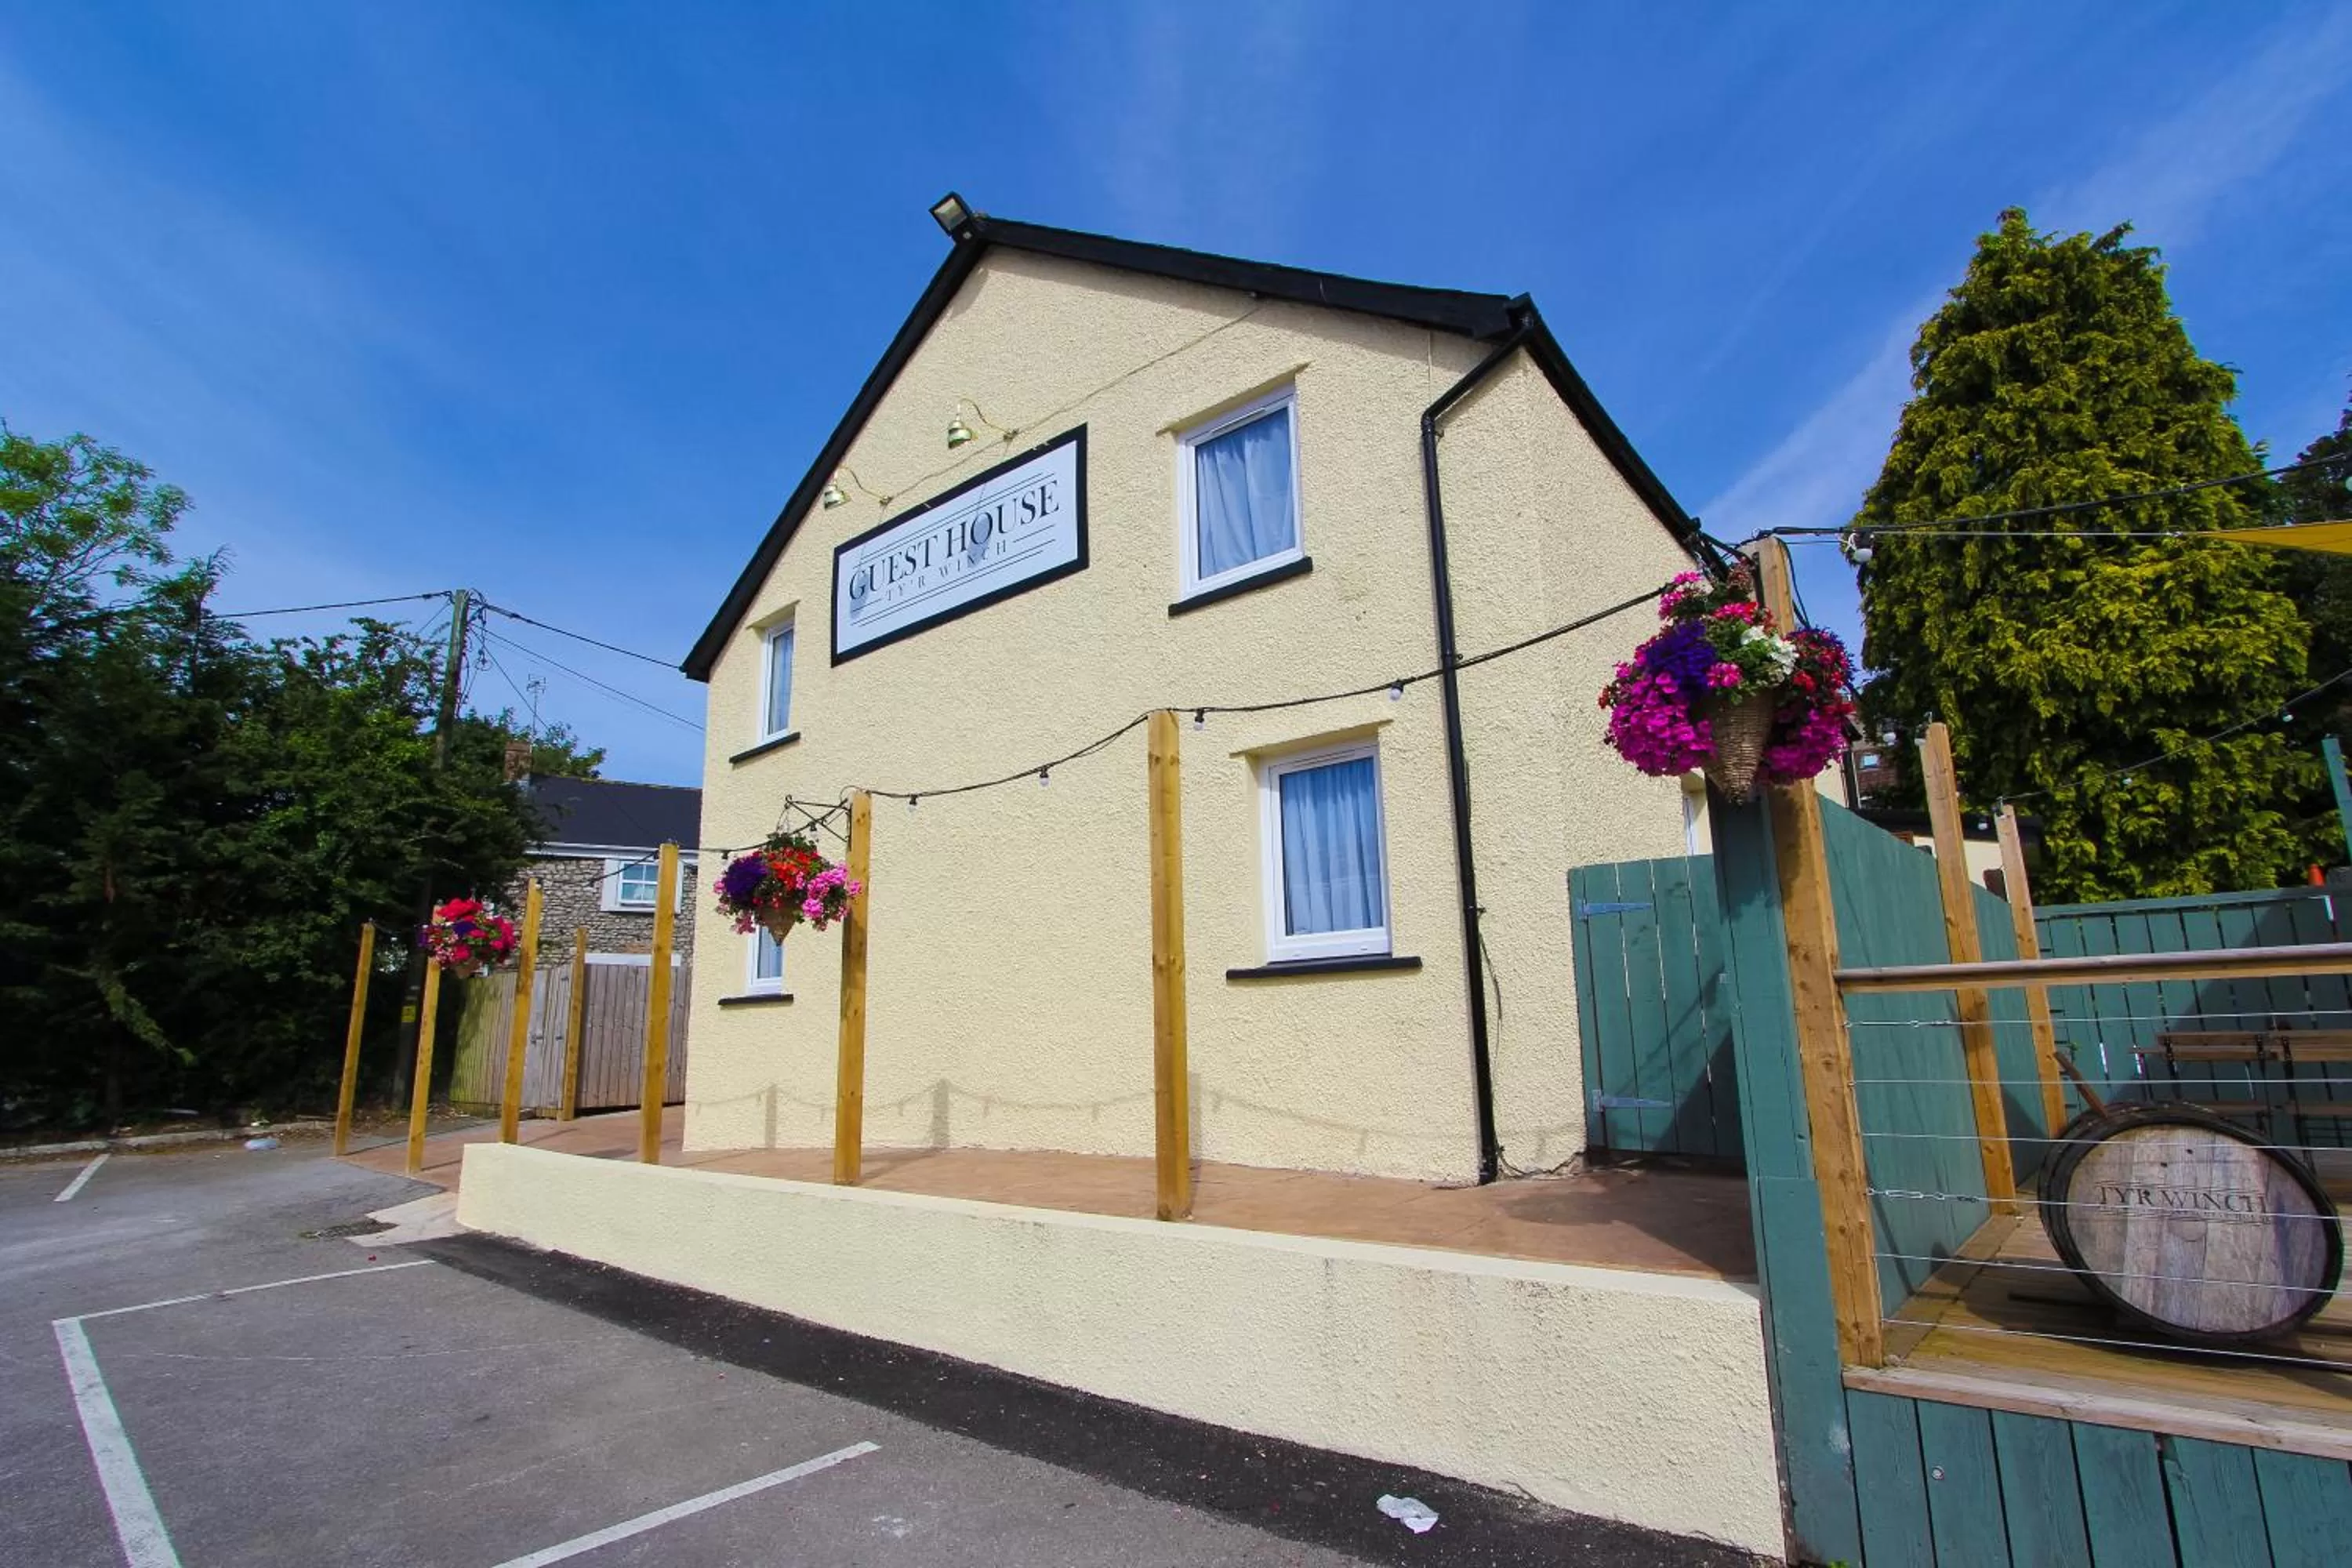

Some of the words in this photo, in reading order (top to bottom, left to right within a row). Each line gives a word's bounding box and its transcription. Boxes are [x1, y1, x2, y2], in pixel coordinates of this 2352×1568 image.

[849, 535, 938, 601] GUEST
[946, 480, 1059, 558] HOUSE
[2159, 1189, 2267, 1214] WINCH
